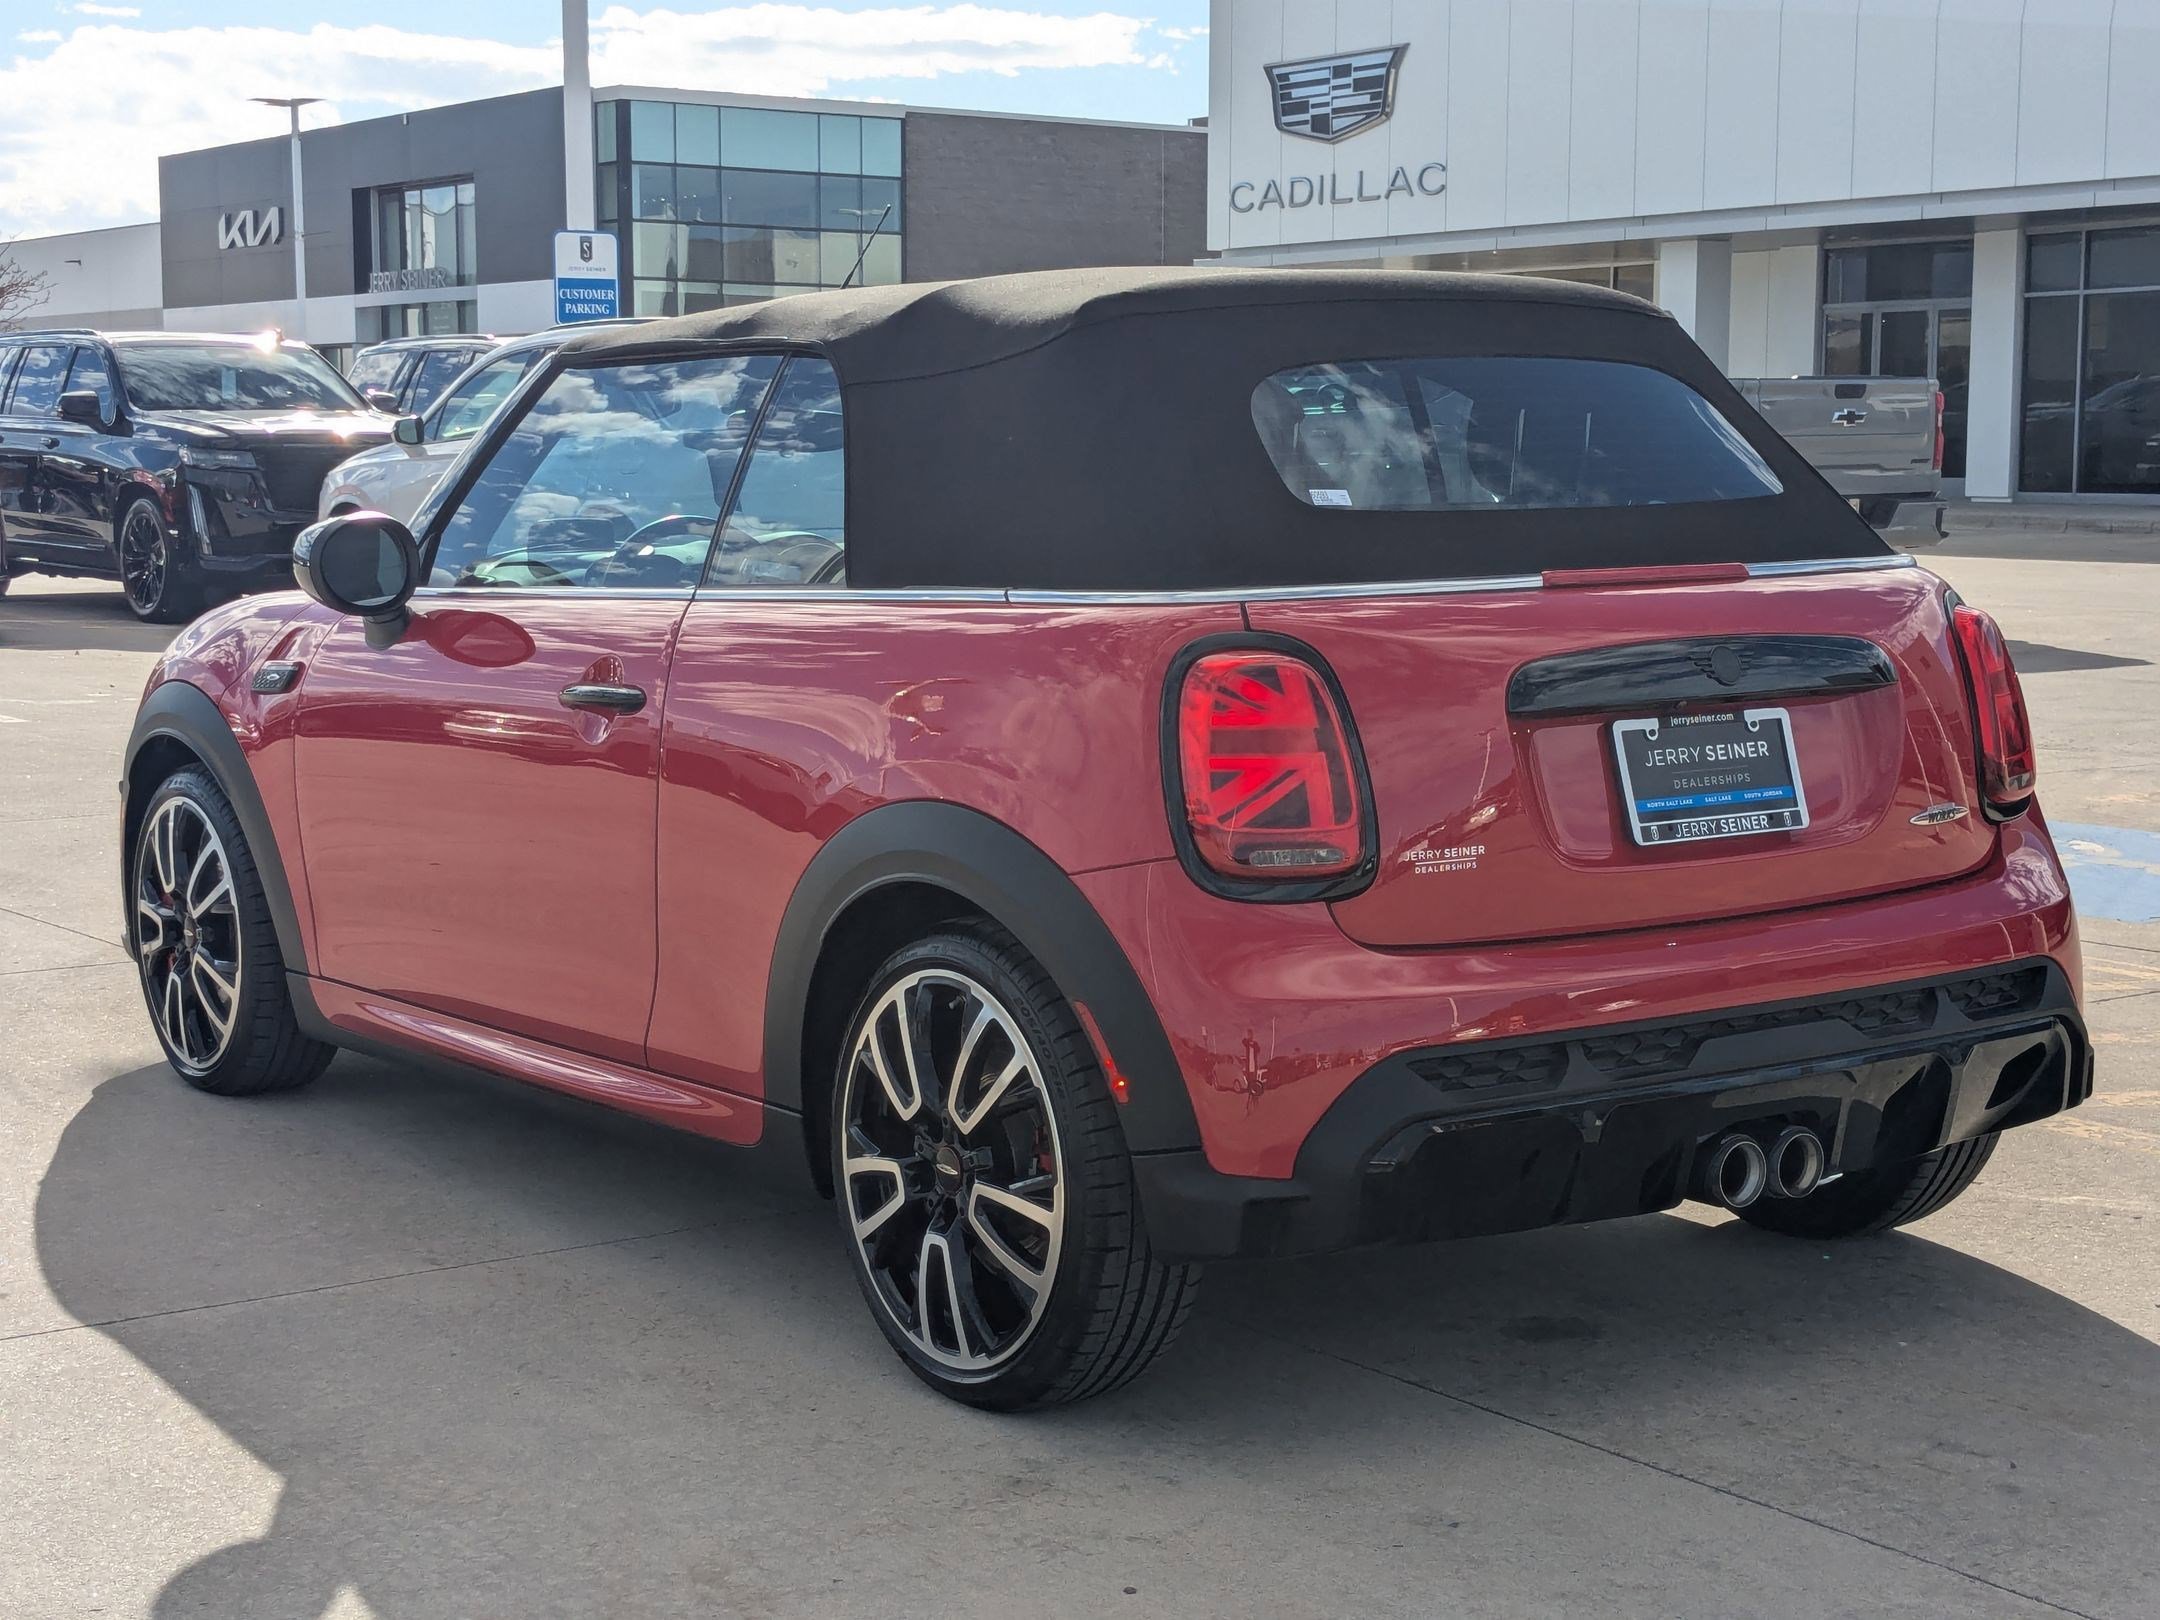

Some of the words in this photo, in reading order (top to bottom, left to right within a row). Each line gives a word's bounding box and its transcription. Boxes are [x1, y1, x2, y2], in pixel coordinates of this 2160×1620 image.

[1230, 162, 1447, 214] CADILLAC
[218, 206, 281, 249] KIA
[367, 271, 399, 293] JERRY
[401, 267, 448, 290] SEINER
[559, 288, 615, 301] CUSTOMER
[565, 303, 610, 315] PARKING
[1670, 713, 1734, 727] jerryseiner.com
[1645, 746, 1701, 767] JERRY
[1706, 741, 1770, 762] SEINER
[1673, 773, 1751, 790] DEALERSHIPS
[1762, 789, 1783, 797] JORDAN
[1675, 820, 1717, 838] JERRY
[1720, 815, 1769, 833] SEINER
[1404, 849, 1442, 862] JERRY
[1444, 845, 1485, 858] SEINER
[1415, 862, 1476, 873] DEALERSHIPS
